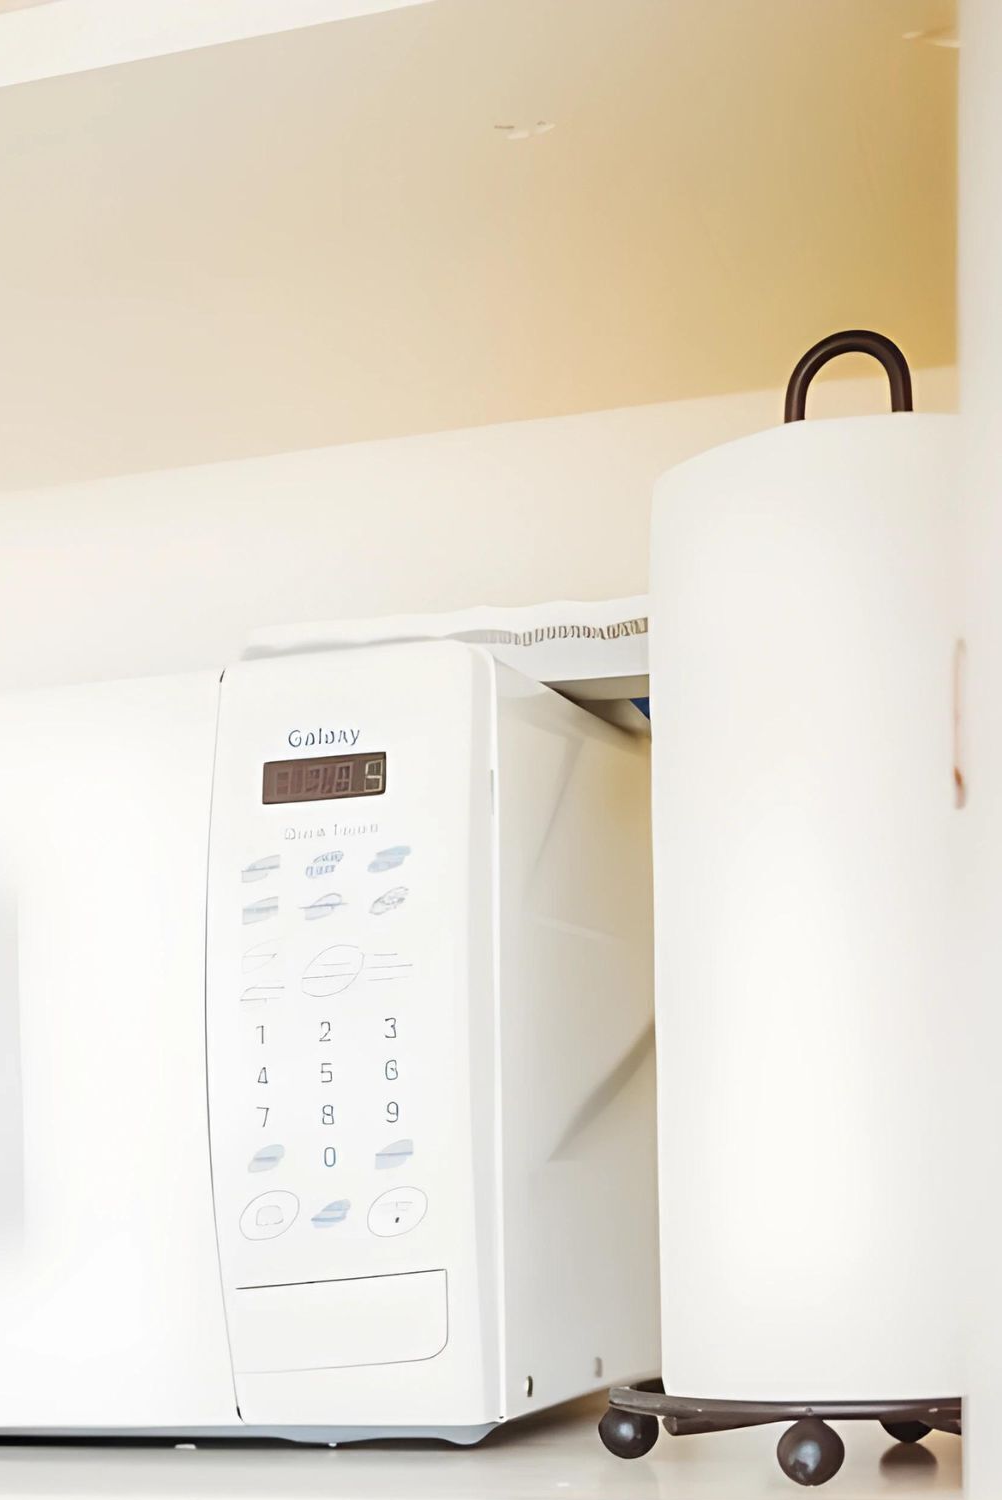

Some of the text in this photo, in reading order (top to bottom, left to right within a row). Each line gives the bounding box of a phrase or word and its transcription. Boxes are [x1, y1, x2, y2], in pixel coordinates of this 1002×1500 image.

[255, 1016, 398, 1045] 1 2 3
[256, 1058, 399, 1085] 4 5 6
[255, 1100, 400, 1129] 7 8 9
[323, 1146, 337, 1168] 0
